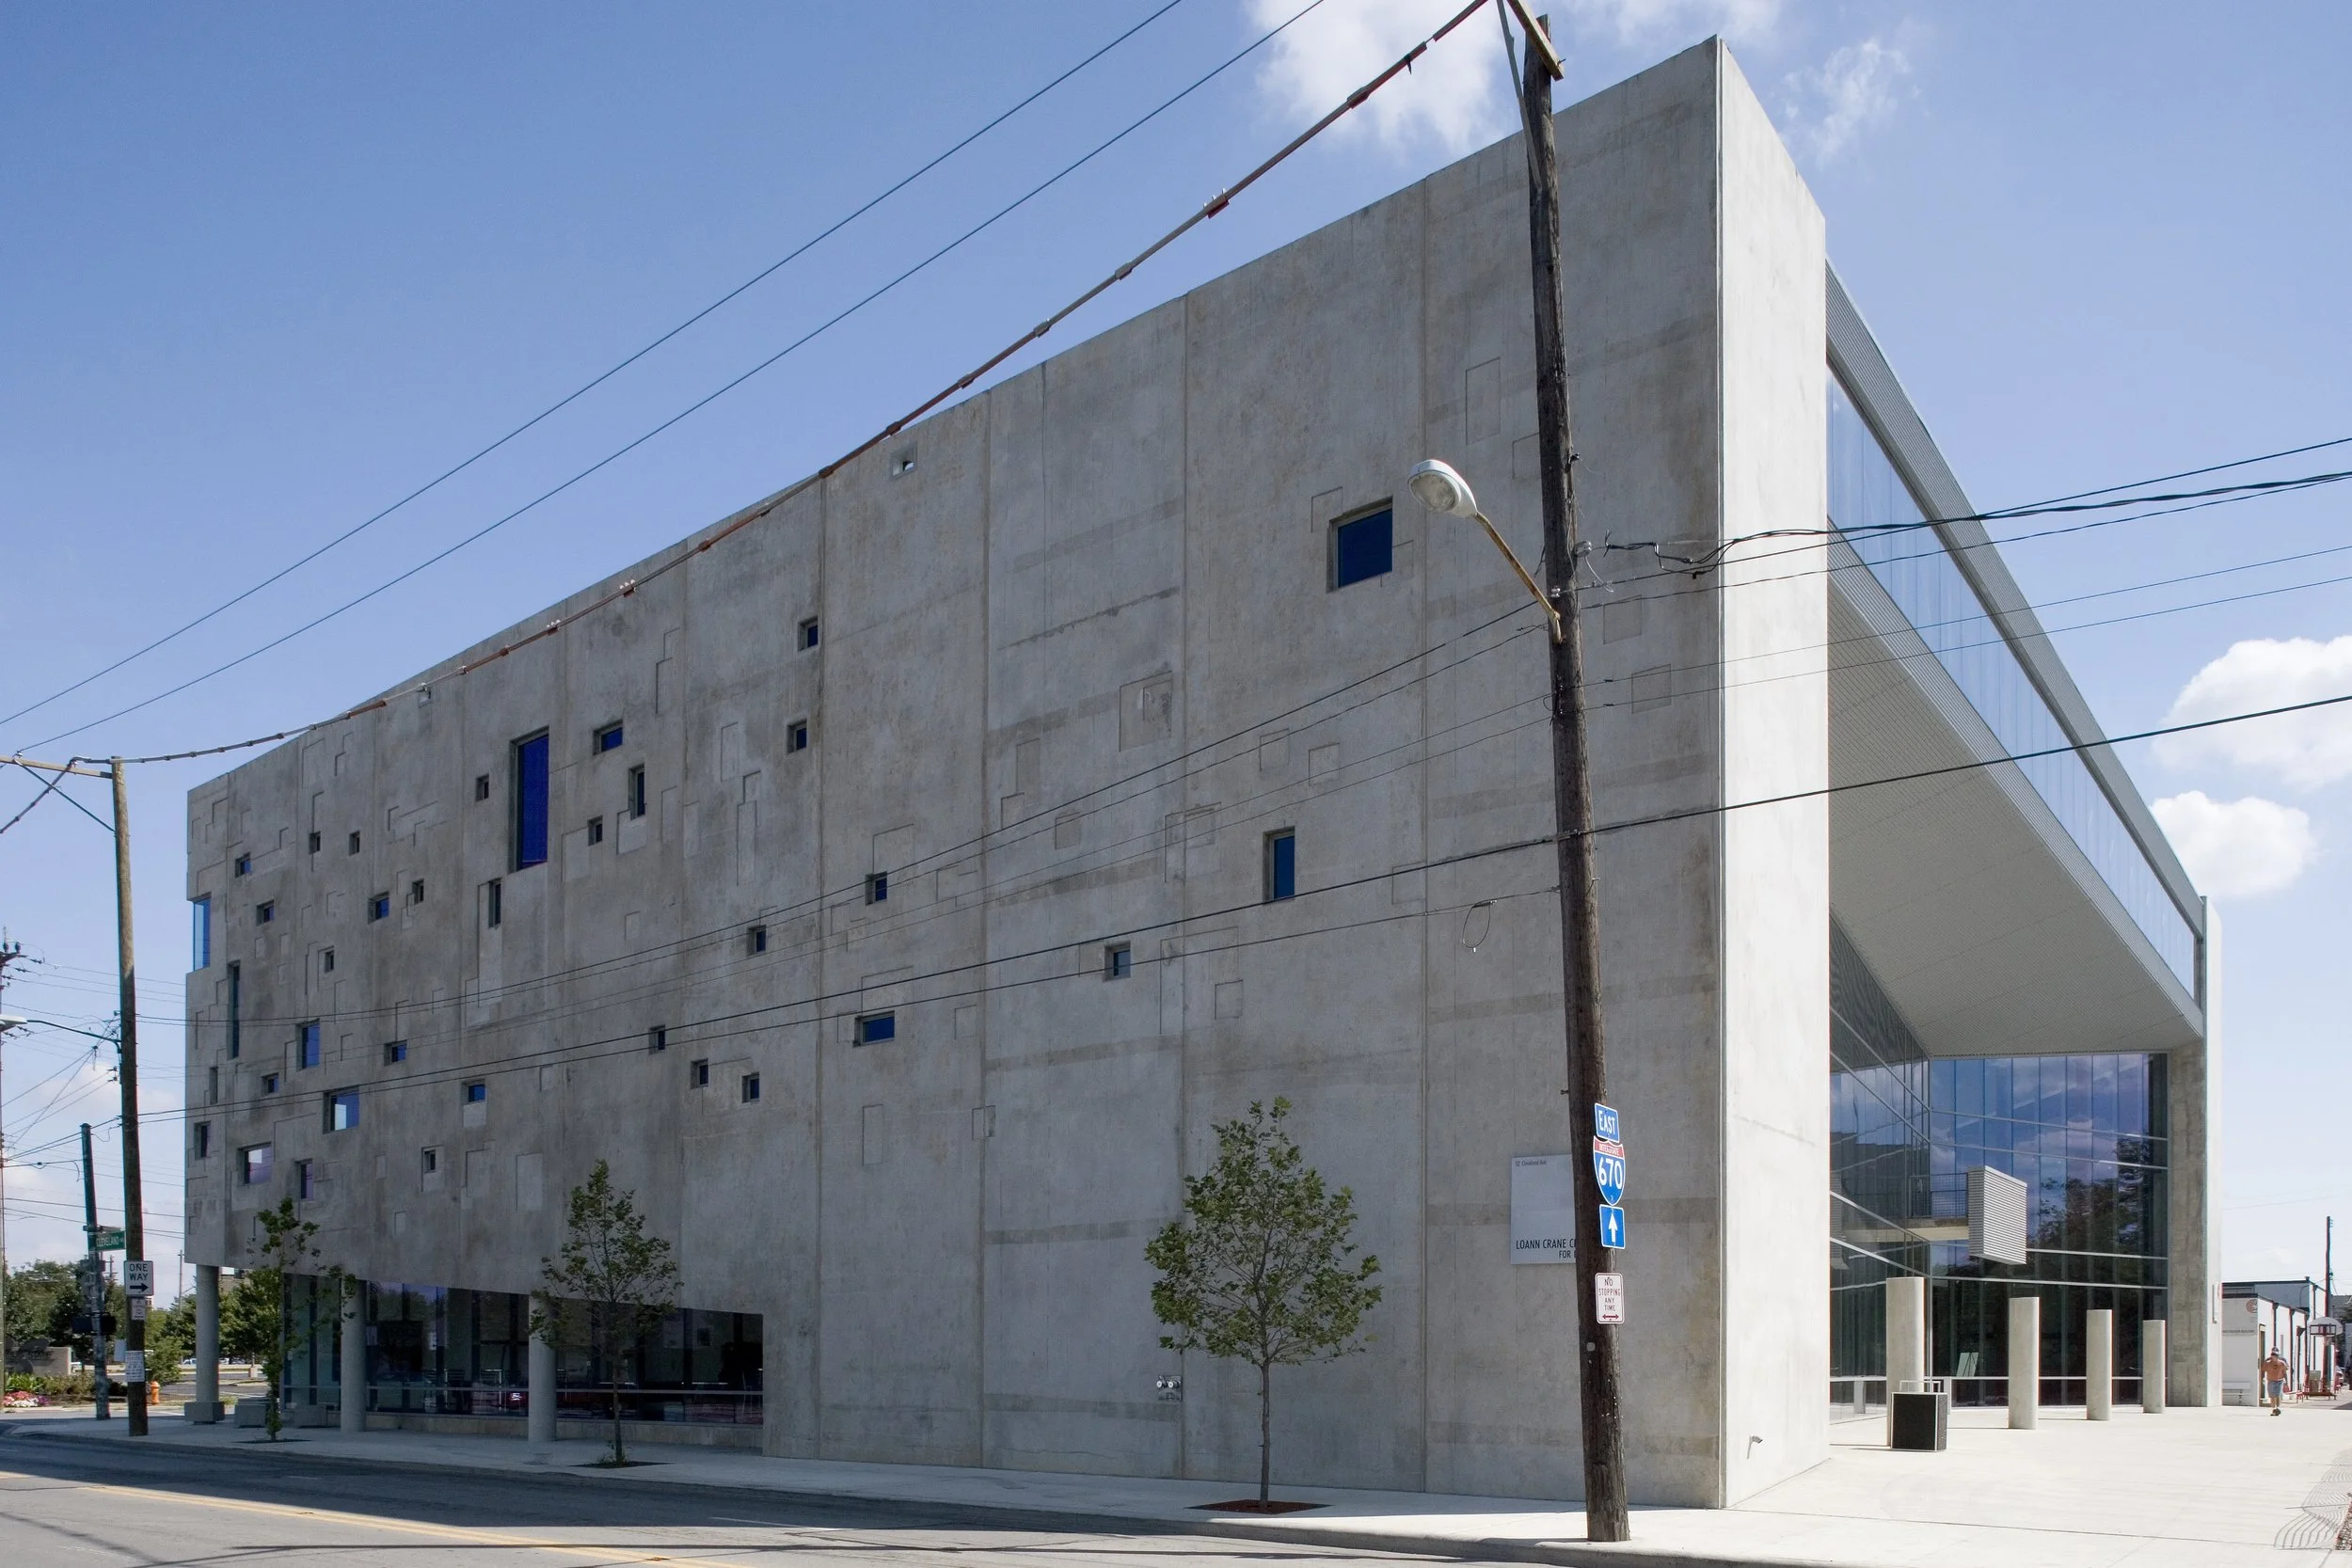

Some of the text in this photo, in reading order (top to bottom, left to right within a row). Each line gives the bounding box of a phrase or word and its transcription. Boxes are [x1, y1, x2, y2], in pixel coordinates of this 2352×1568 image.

[1598, 1110, 1615, 1134] EAST
[1599, 1143, 1620, 1156] INTERSTATE
[1598, 1156, 1623, 1190] 670
[1516, 1240, 1540, 1249] LOANN
[1543, 1239, 1566, 1249] CRANE
[1559, 1250, 1571, 1259] FOR
[129, 1263, 148, 1272] ONE
[129, 1273, 149, 1281] WAY
[1604, 1278, 1613, 1287] NO
[1598, 1288, 1621, 1296] STOPPING
